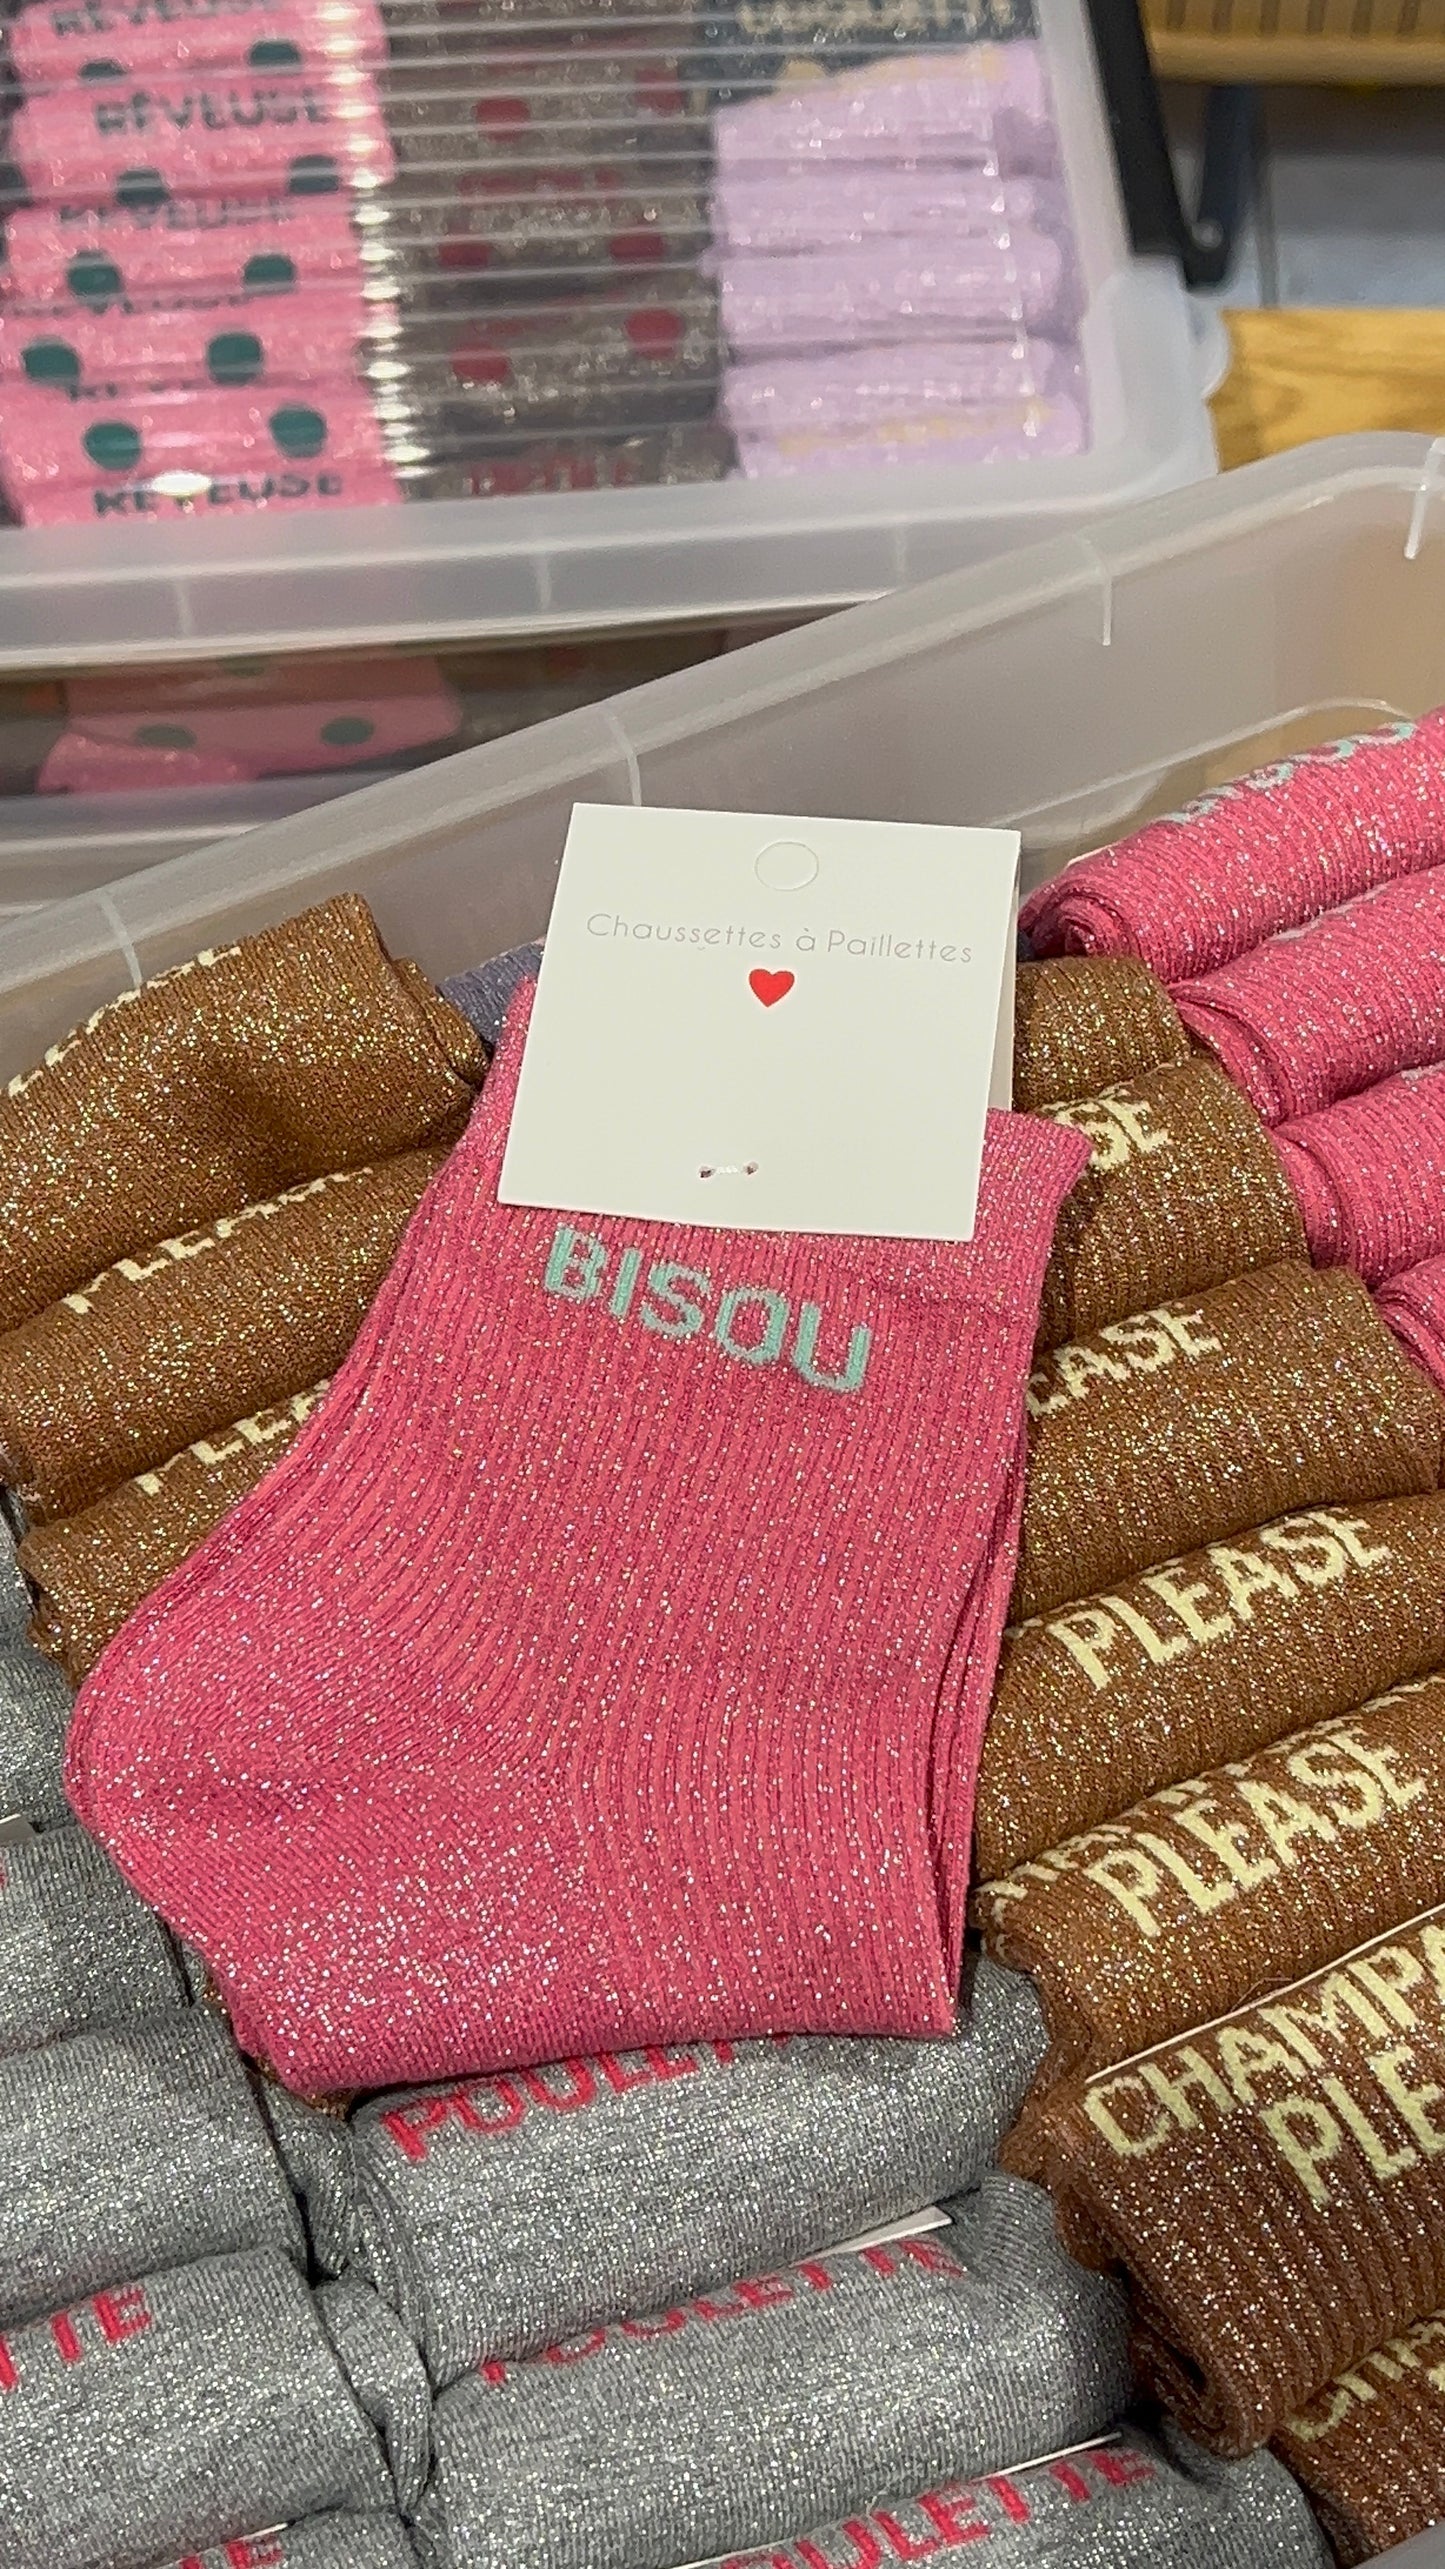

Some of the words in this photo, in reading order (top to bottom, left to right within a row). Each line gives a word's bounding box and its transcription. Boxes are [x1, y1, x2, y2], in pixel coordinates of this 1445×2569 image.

[587, 912, 782, 949] Chaussettes
[795, 927, 816, 953] à
[827, 929, 974, 964] Paillettes
[543, 1222, 871, 1393] BISOU
[1046, 1508, 1394, 1691] PLEASE
[1083, 1727, 1428, 1938] PLEASE
